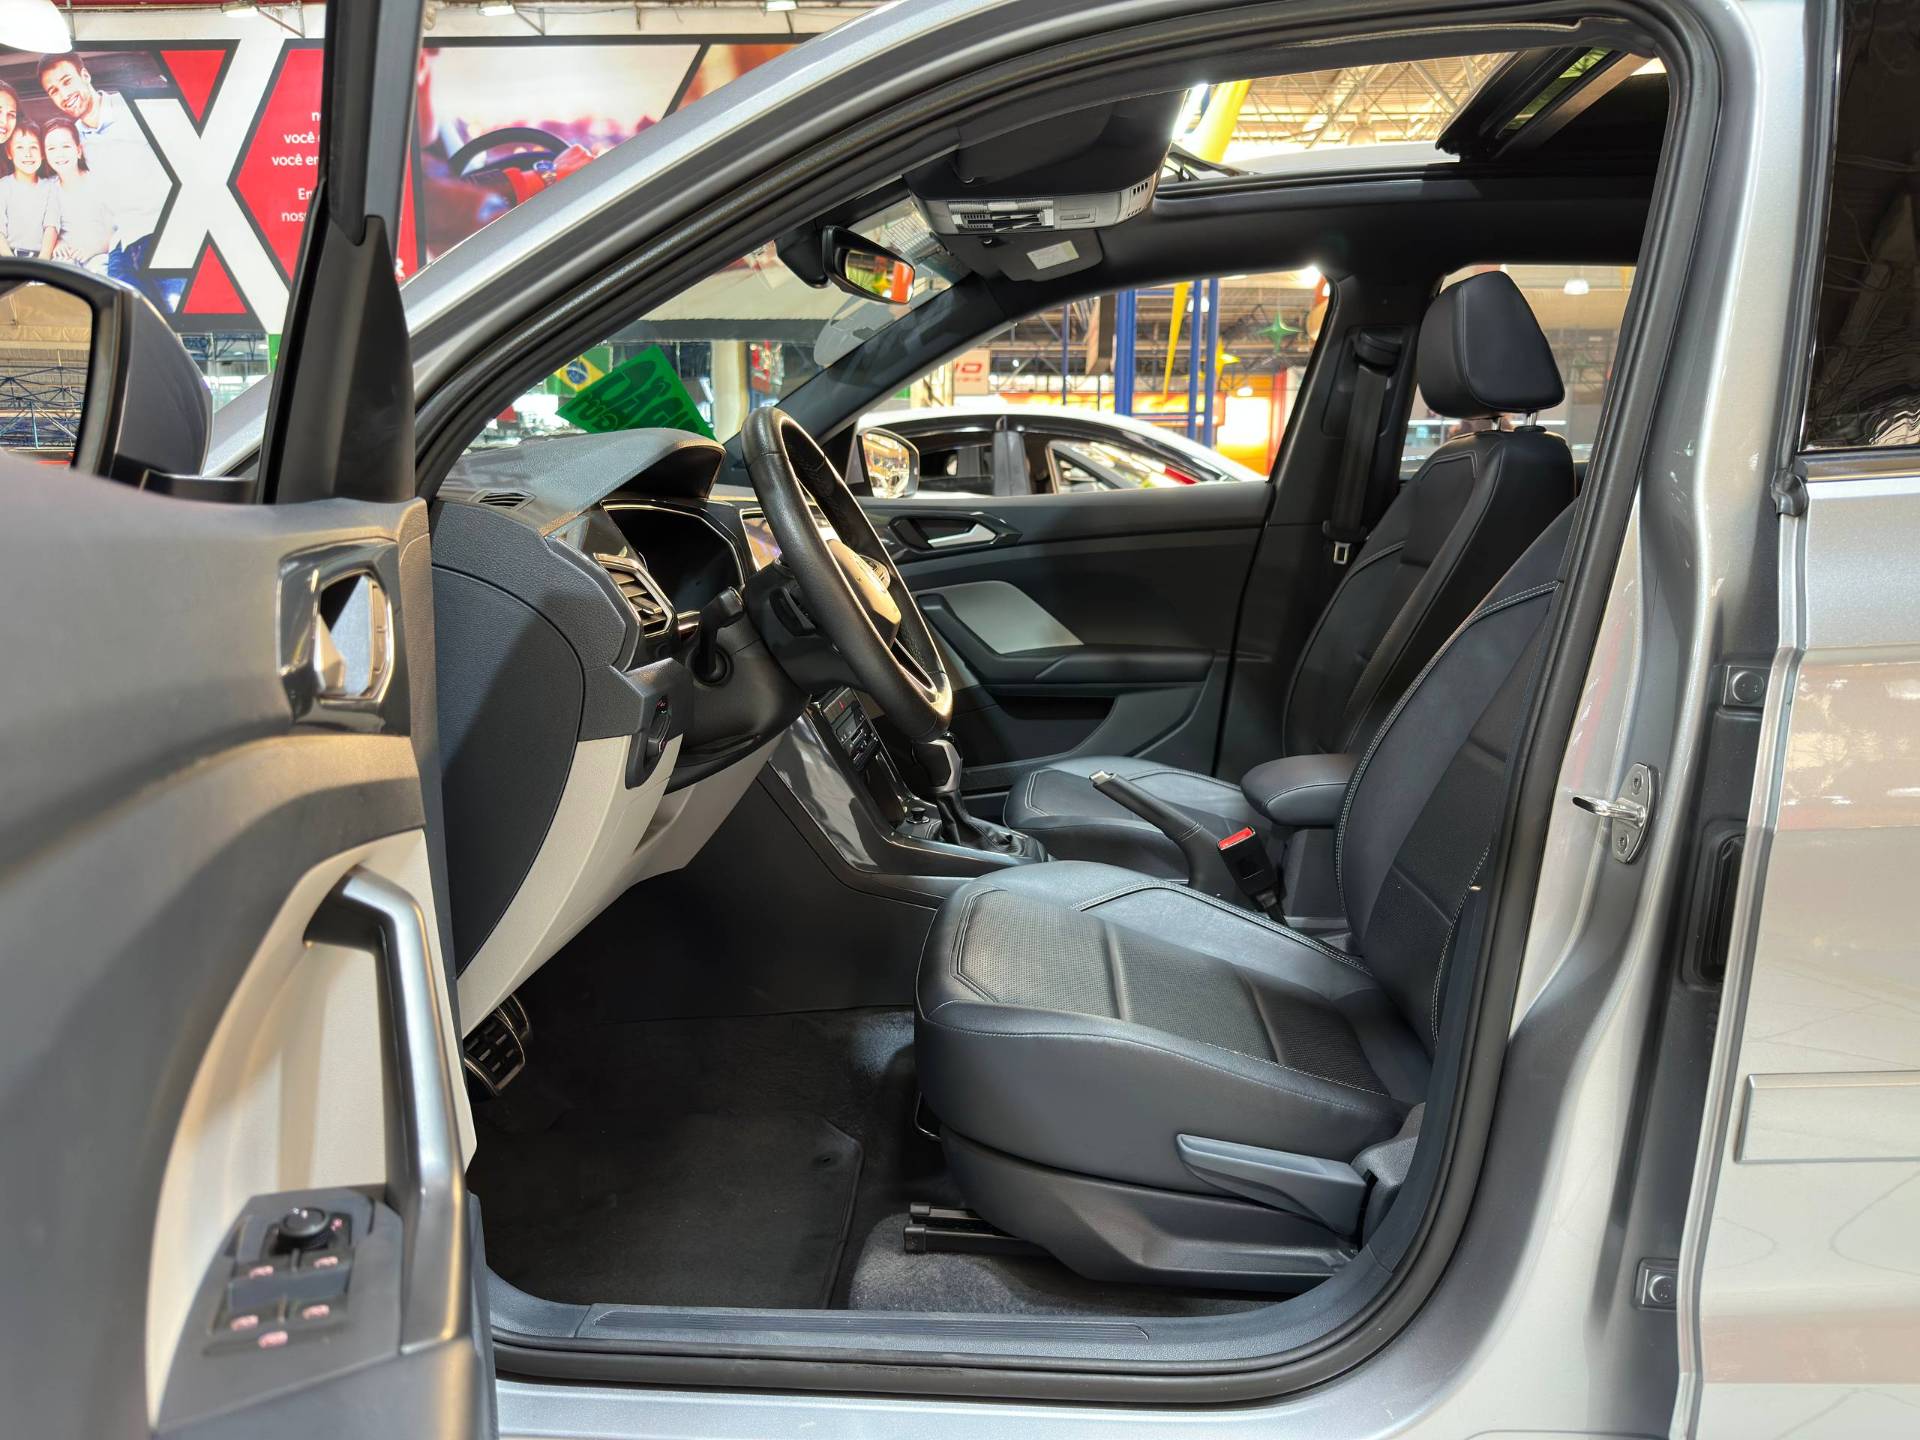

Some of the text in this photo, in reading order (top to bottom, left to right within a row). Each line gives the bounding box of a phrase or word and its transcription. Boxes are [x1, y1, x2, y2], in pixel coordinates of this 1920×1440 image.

[284, 131, 315, 144] você
[272, 154, 303, 166] você
[281, 211, 307, 222] nos
